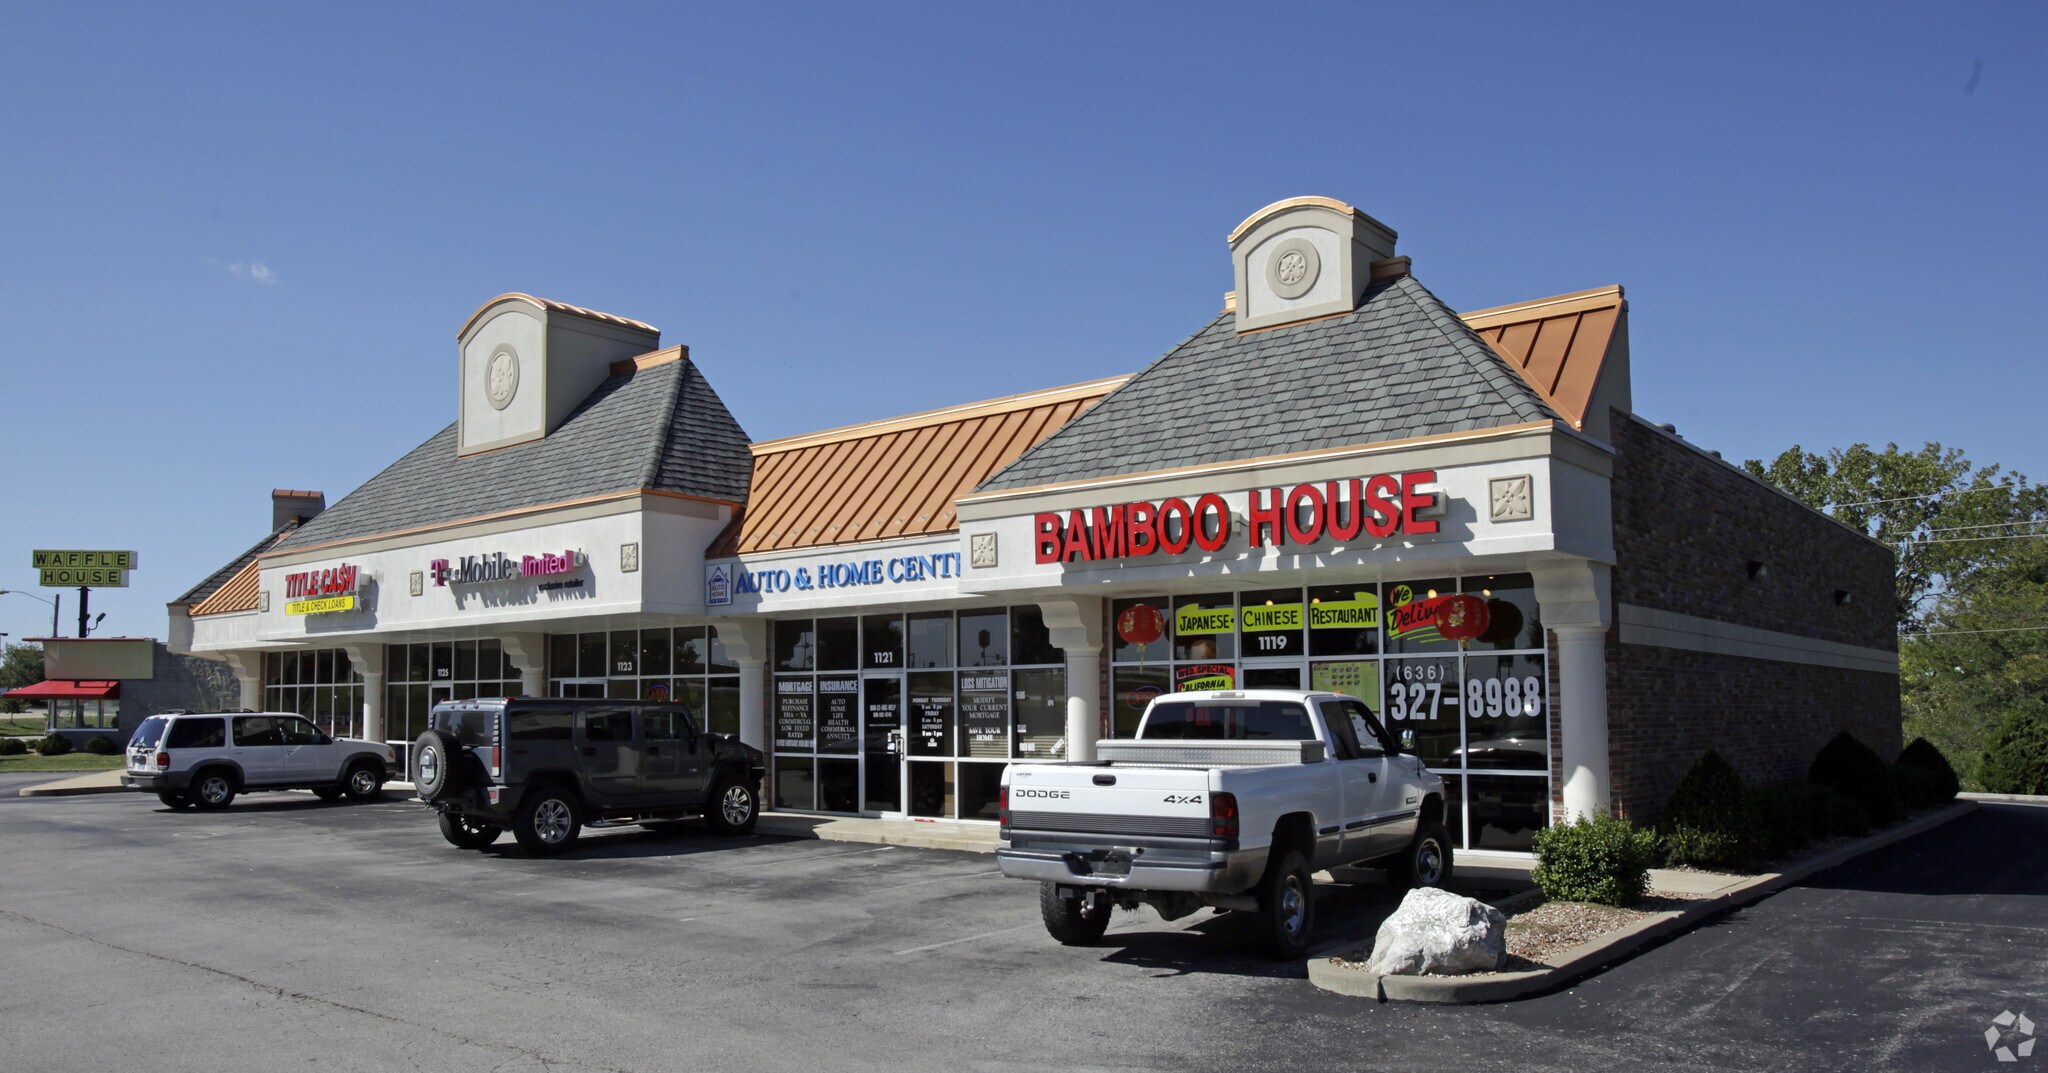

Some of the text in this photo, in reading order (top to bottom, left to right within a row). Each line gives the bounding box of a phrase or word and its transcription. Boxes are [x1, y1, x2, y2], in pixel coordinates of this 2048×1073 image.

[1034, 469, 1441, 565] BAMBOO HOUSE
[35, 553, 127, 582] WAFFLE HOUSE
[521, 549, 573, 577] limited
[285, 570, 320, 598] TITLE
[734, 569, 792, 594] AUTO
[794, 566, 815, 591] &
[817, 560, 884, 588] HOME
[538, 580, 564, 591] exclusive
[1393, 586, 1410, 605] We
[292, 598, 346, 613] TITLE & CHECK LOANS
[1243, 610, 1298, 628] CHINESE
[1311, 607, 1378, 625] RESTAURANT
[1258, 636, 1287, 650] 1119
[874, 651, 893, 663] 1121
[617, 661, 633, 671] 1123
[1196, 665, 1229, 676] SPECIAL
[1396, 665, 1444, 681] (636)
[778, 681, 813, 692] MORTGAGE
[820, 680, 858, 691] INSURANCE
[961, 676, 1008, 690] LOSS MITIGATION
[1180, 679, 1225, 692] CALIFORNIA
[969, 711, 1000, 719] MORTGAGE
[1015, 789, 1071, 799] DODGE
